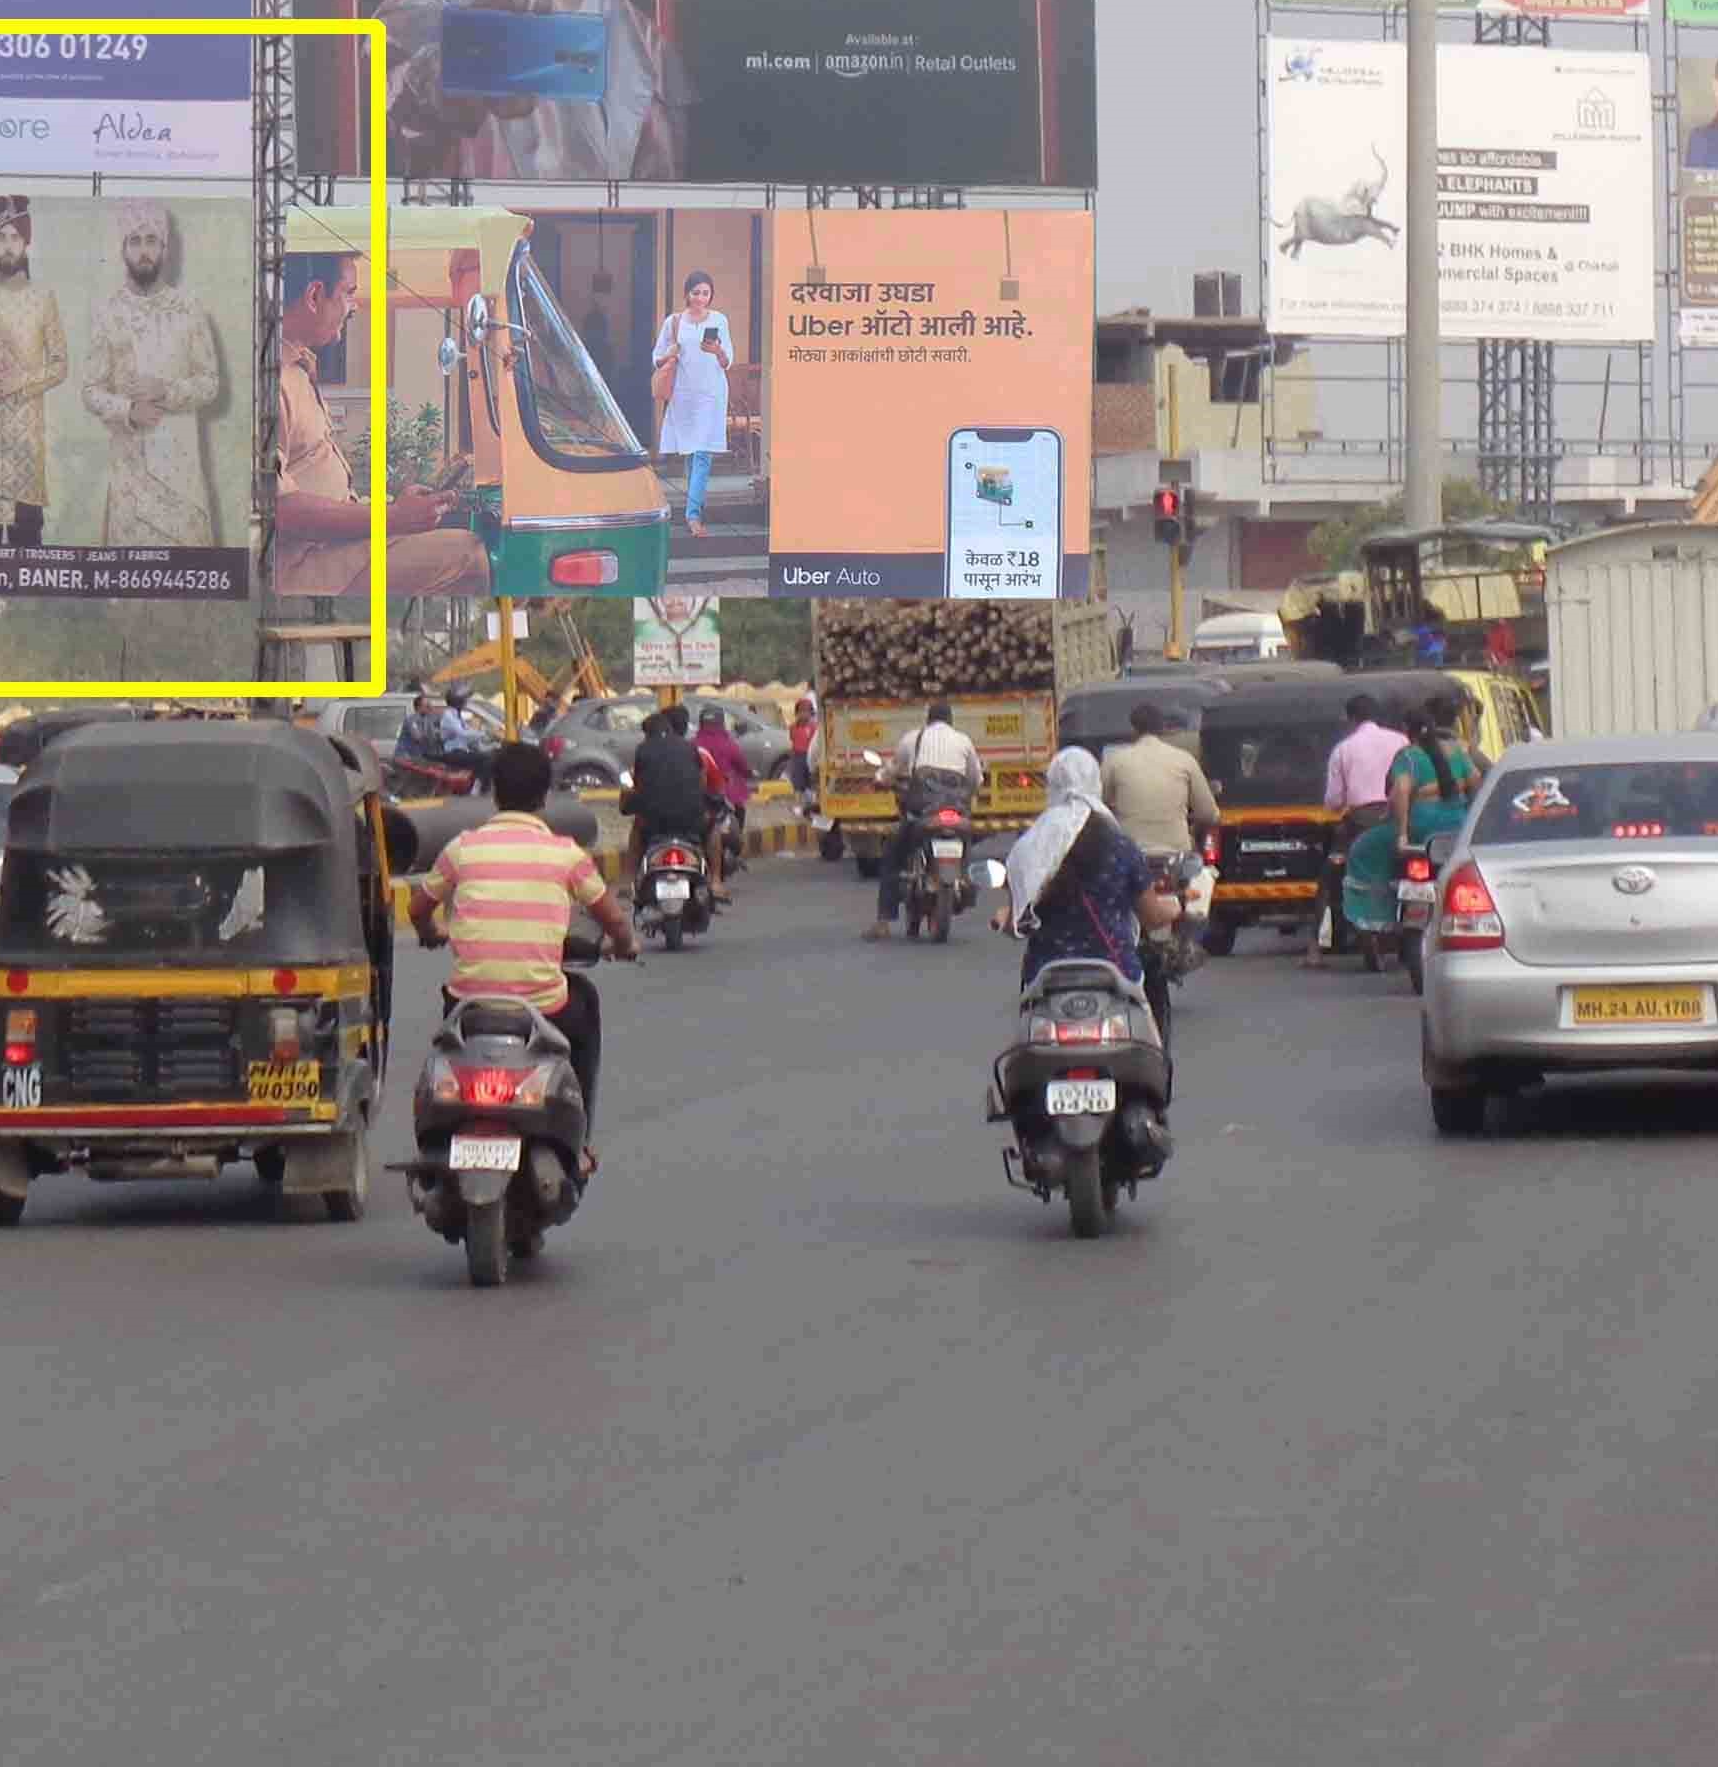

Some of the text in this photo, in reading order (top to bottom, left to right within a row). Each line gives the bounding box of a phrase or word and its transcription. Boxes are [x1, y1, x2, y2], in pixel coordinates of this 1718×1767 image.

[60, 33, 148, 61] 01249
[845, 33, 899, 46] Available
[746, 53, 810, 70] mi.com
[960, 56, 1017, 73] Outlets
[1446, 176, 1532, 194] ELEPHANTS
[1451, 243, 1484, 260] BHK
[1490, 244, 1542, 261] Homes
[1504, 266, 1559, 285] Spaces
[790, 282, 935, 304] दरवाजा उघडा
[788, 308, 1033, 340] Uber ऑटो आली आहे.
[898, 346, 928, 364] छोटी
[25, 548, 75, 561] TROUSERS
[85, 550, 117, 562] JEANS
[128, 550, 170, 562] FABRICS
[965, 549, 1040, 568] केवळ ₹18
[93, 569, 231, 591] M-8669445286
[783, 568, 881, 586] Uber Auto
[964, 570, 1041, 591] पासून आरंभ
[3, 1066, 41, 1107] CNG
